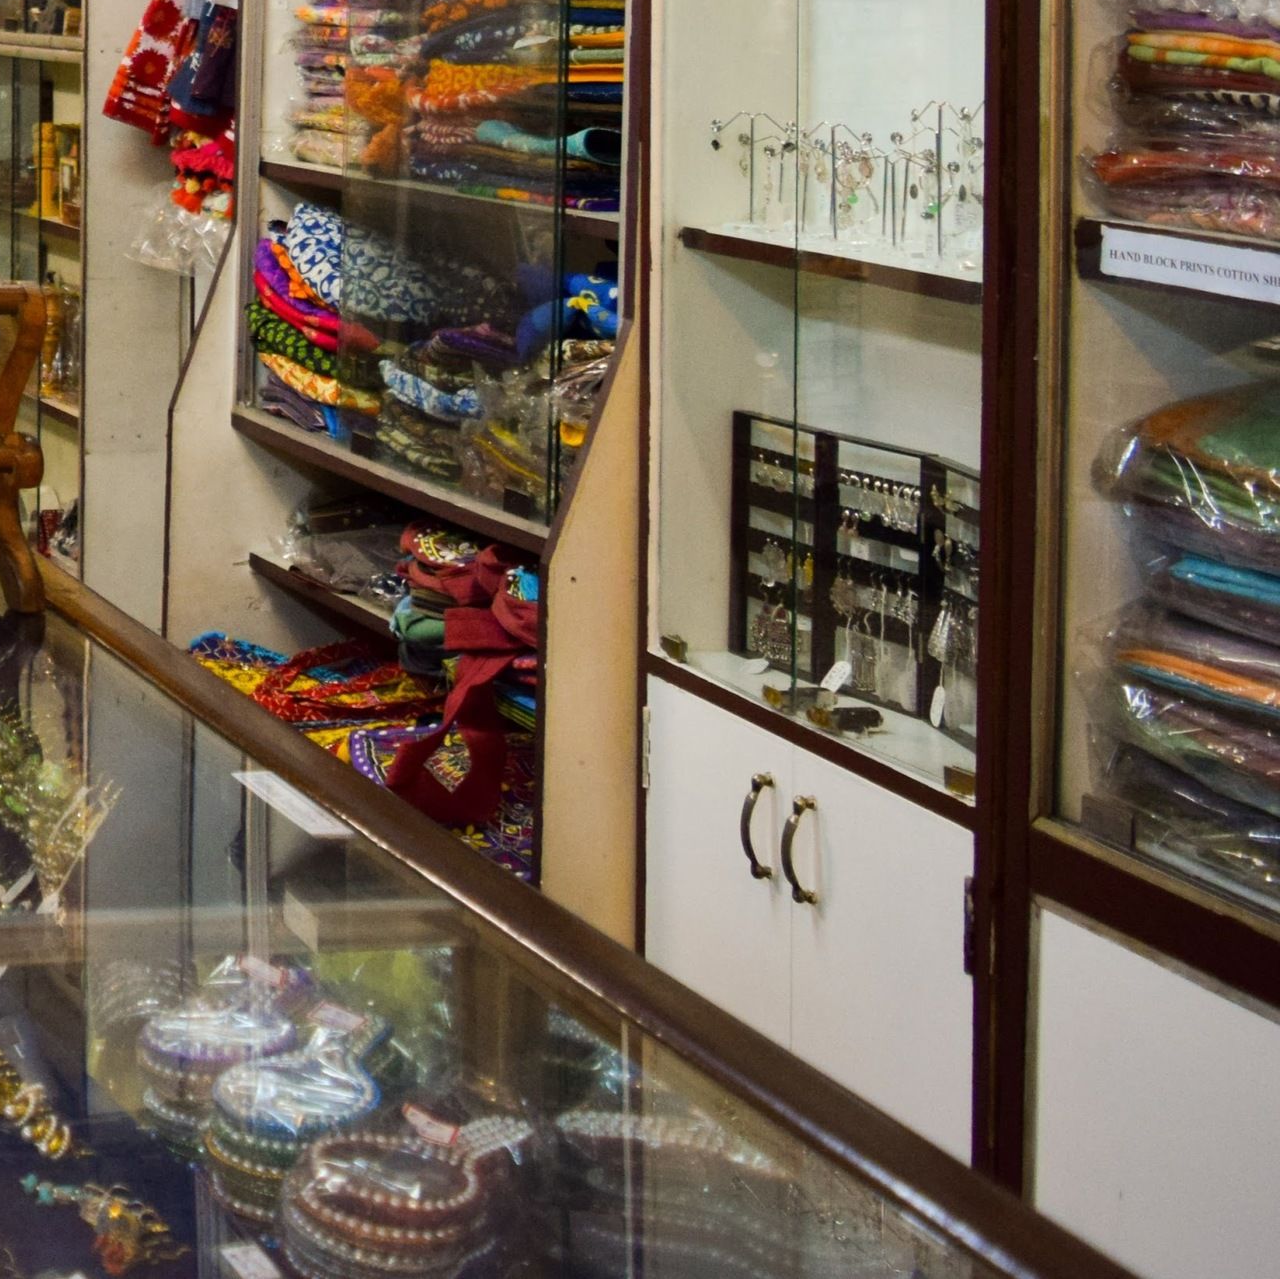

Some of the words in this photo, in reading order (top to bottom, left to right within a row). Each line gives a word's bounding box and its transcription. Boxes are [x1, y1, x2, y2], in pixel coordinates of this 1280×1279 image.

[1109, 248, 1141, 262] HAND
[1143, 254, 1177, 270] BLOCK
[1180, 260, 1215, 276] PRINTS
[1217, 266, 1260, 284] COTTON
